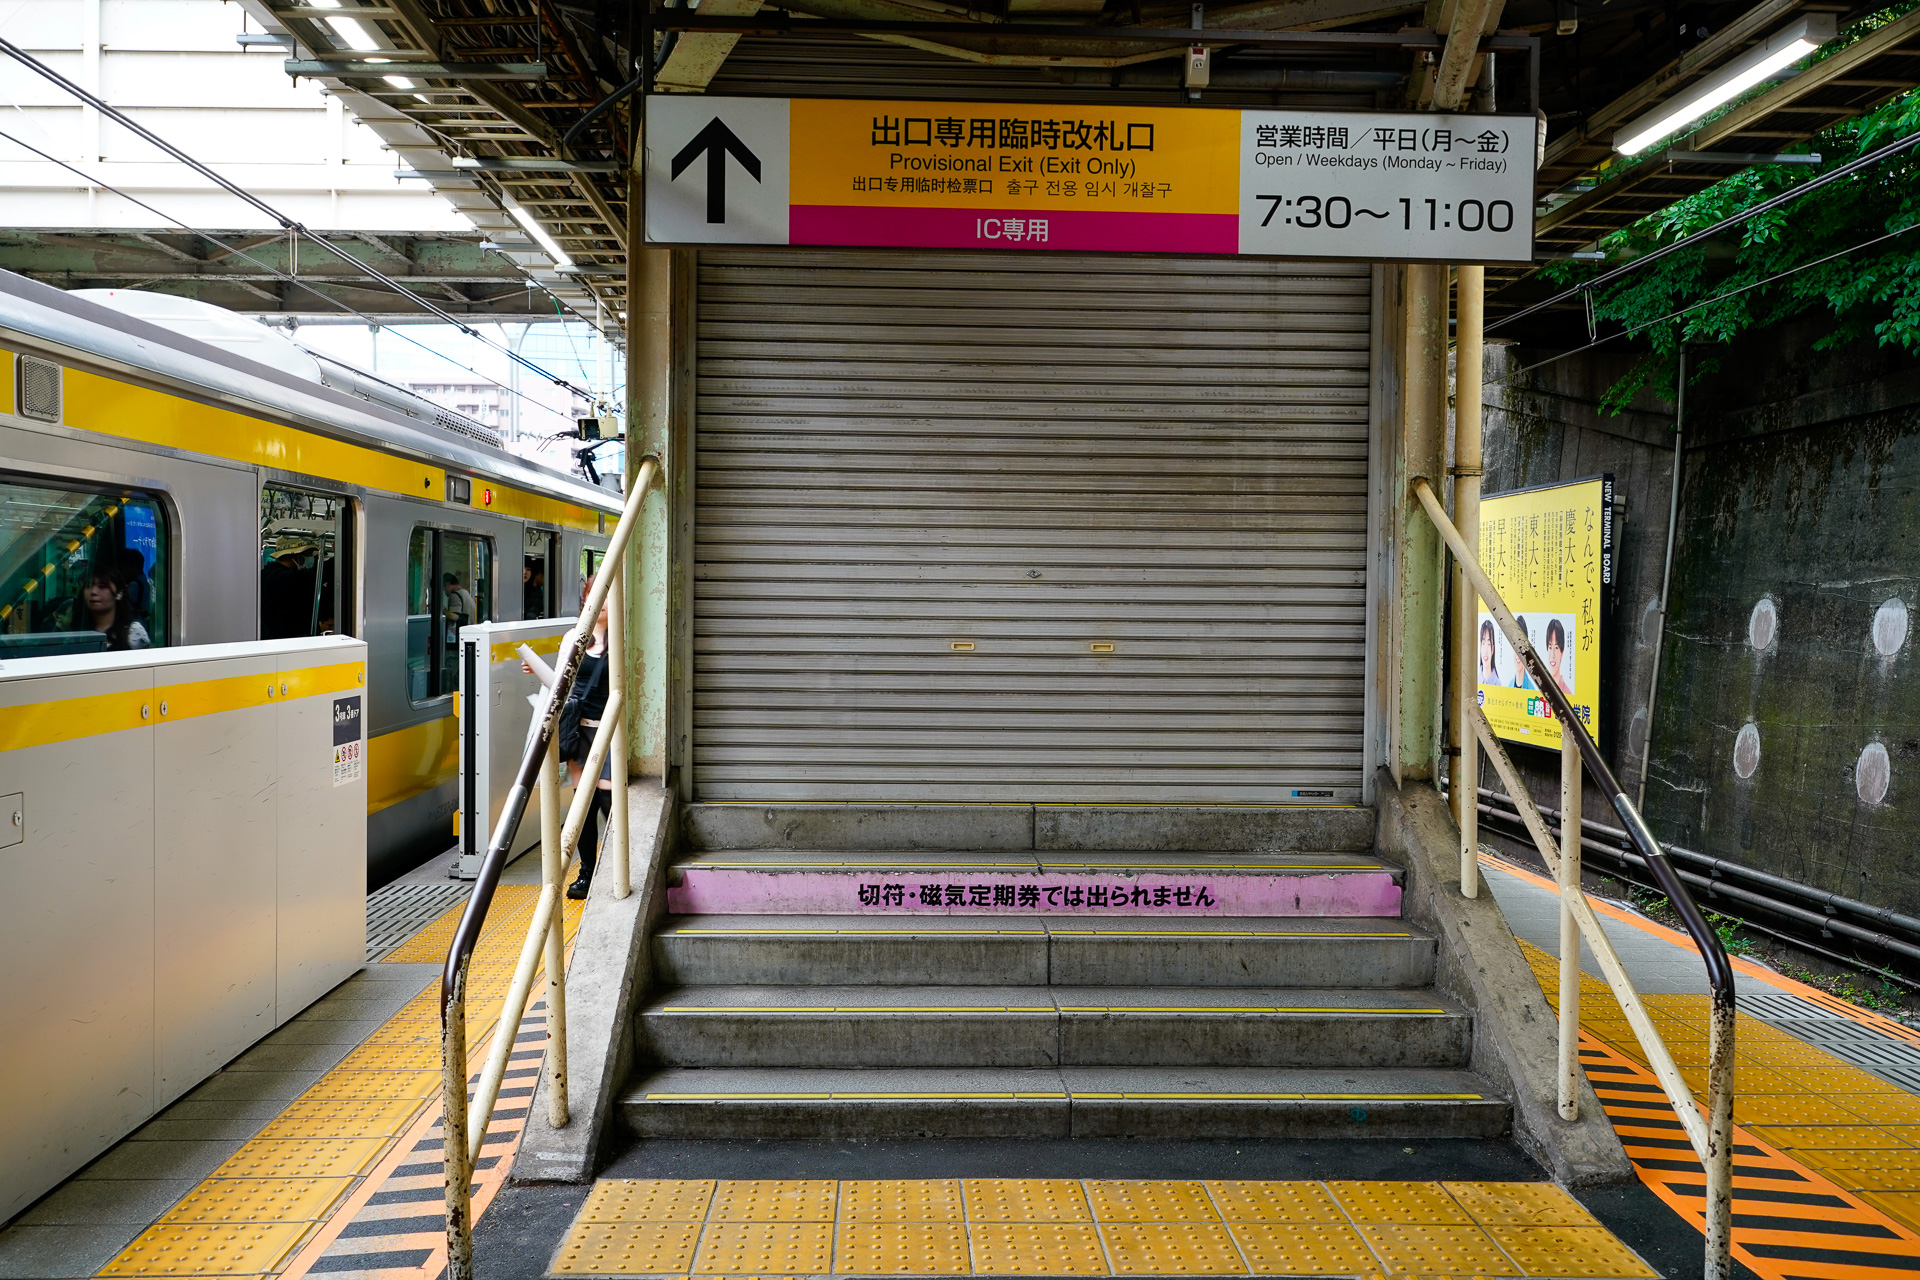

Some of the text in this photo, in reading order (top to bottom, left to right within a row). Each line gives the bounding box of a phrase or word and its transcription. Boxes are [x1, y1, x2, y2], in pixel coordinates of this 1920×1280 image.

[871, 115, 1155, 152] 出口専用臨時改札口
[890, 153, 1136, 180] Provisional Exit (Exit Only)
[1255, 152, 1293, 168] Open
[1306, 153, 1378, 170] Weekdays
[1382, 154, 1442, 173] (Monday
[1460, 156, 1508, 174] Friday)
[853, 176, 993, 195] 出口专用临时检票口
[1006, 179, 1173, 199] 출구 전용 임시 개찰구
[977, 217, 1049, 242] IC専用
[1602, 481, 1612, 584] NEW TERMINAL BOARD
[1496, 518, 1506, 598] 早大に。
[1528, 513, 1539, 598] 東大に。
[1564, 508, 1576, 598] 慶大に。
[1582, 506, 1595, 652] なんで、私が
[858, 883, 1216, 908] 切符・磁気定期券では出られません
